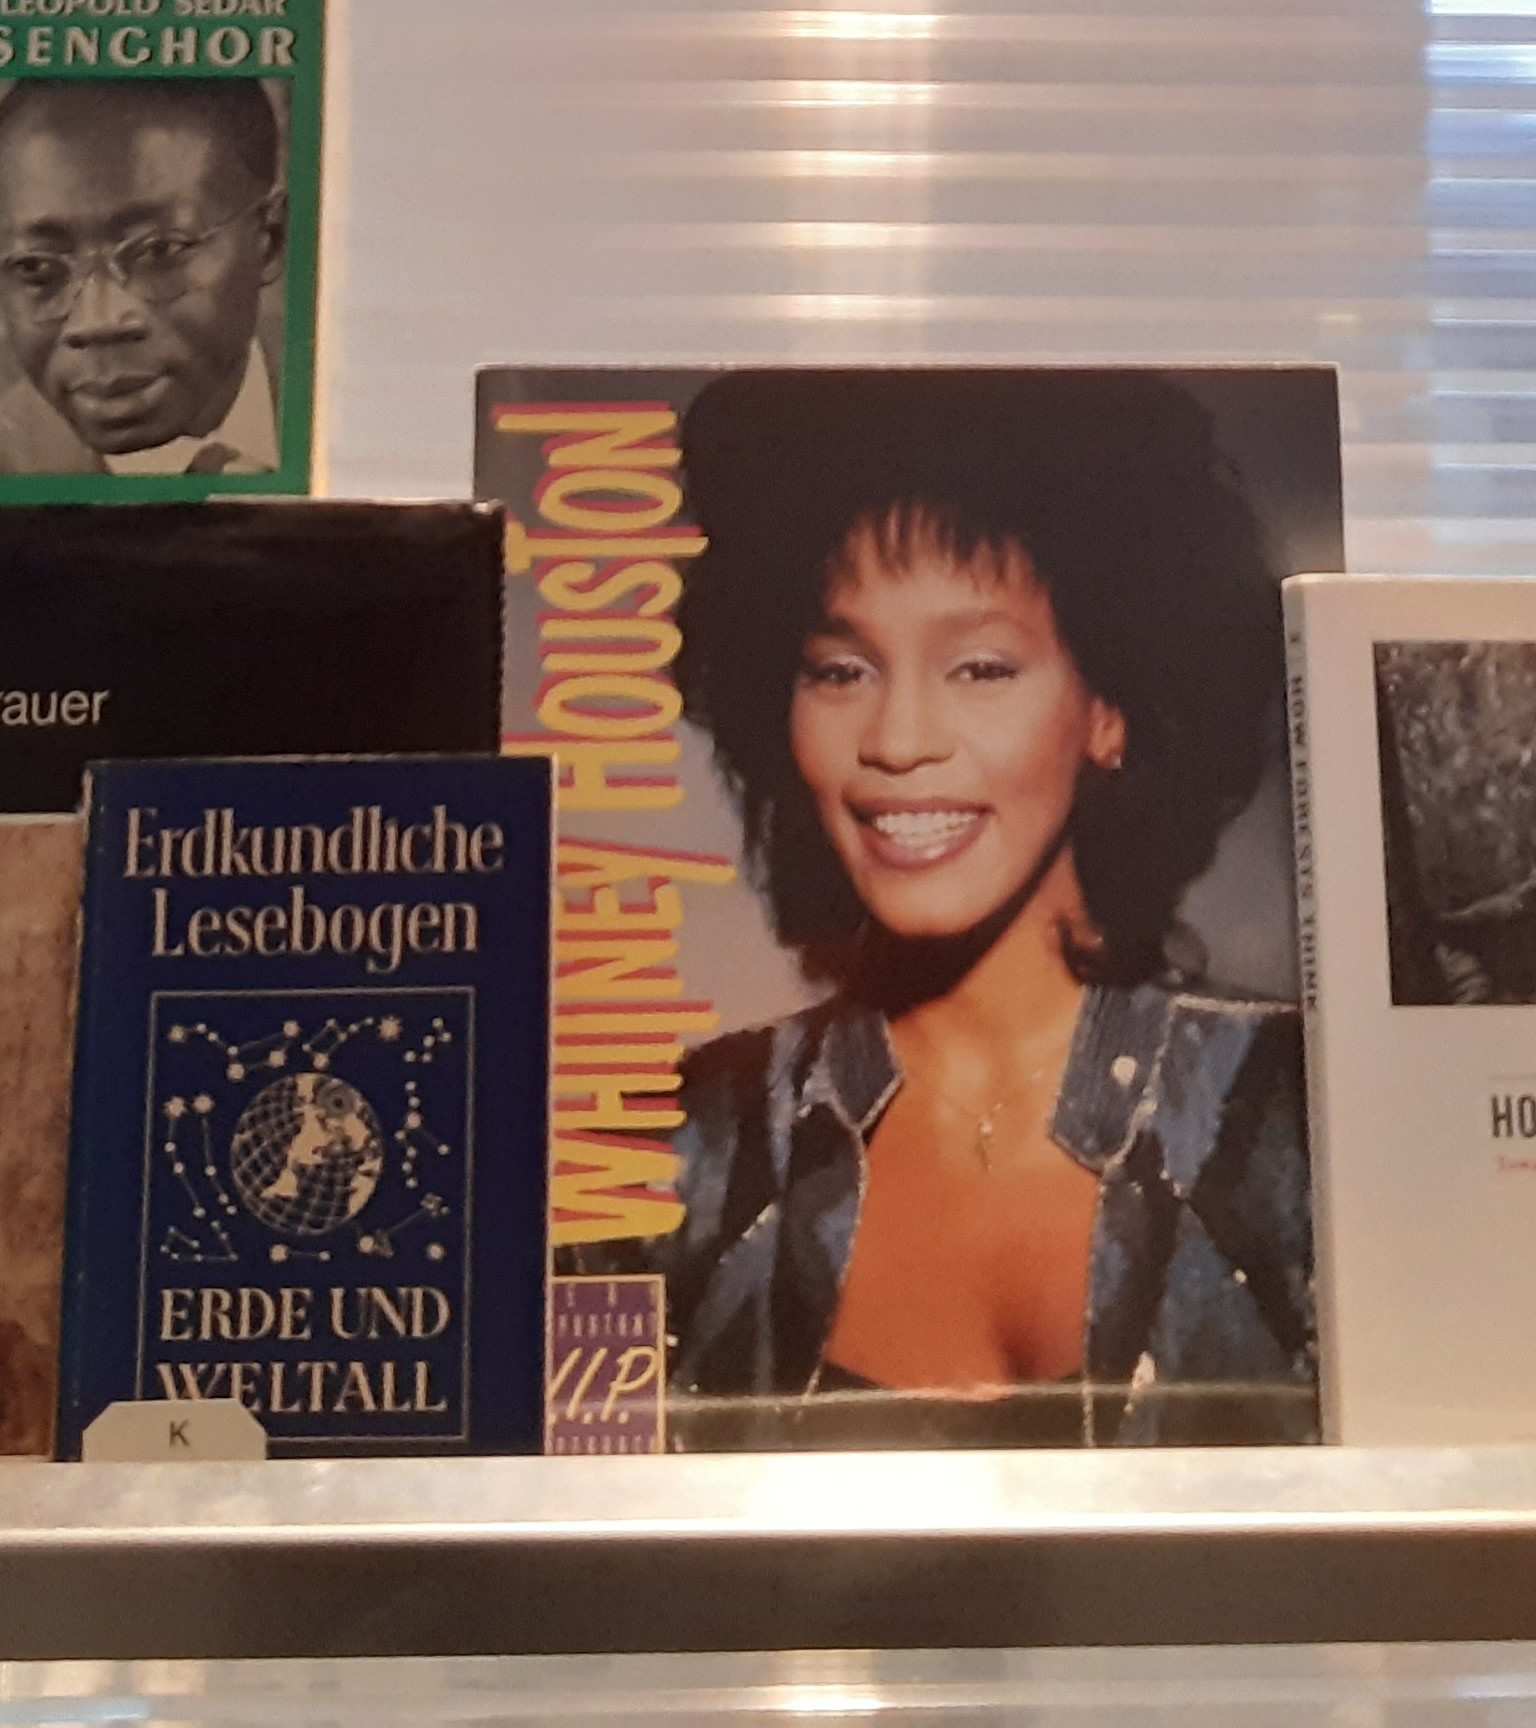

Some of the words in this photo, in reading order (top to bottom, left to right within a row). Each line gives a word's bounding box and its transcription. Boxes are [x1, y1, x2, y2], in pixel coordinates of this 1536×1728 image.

[490, 402, 709, 810] HOUSTON
[124, 805, 503, 877] Erdkundliche
[152, 885, 477, 972] Lesebogen
[160, 1288, 312, 1340] ERDE
[331, 1287, 450, 1339] UND
[156, 1361, 447, 1414] WELTALL
[169, 1421, 190, 1446] K
